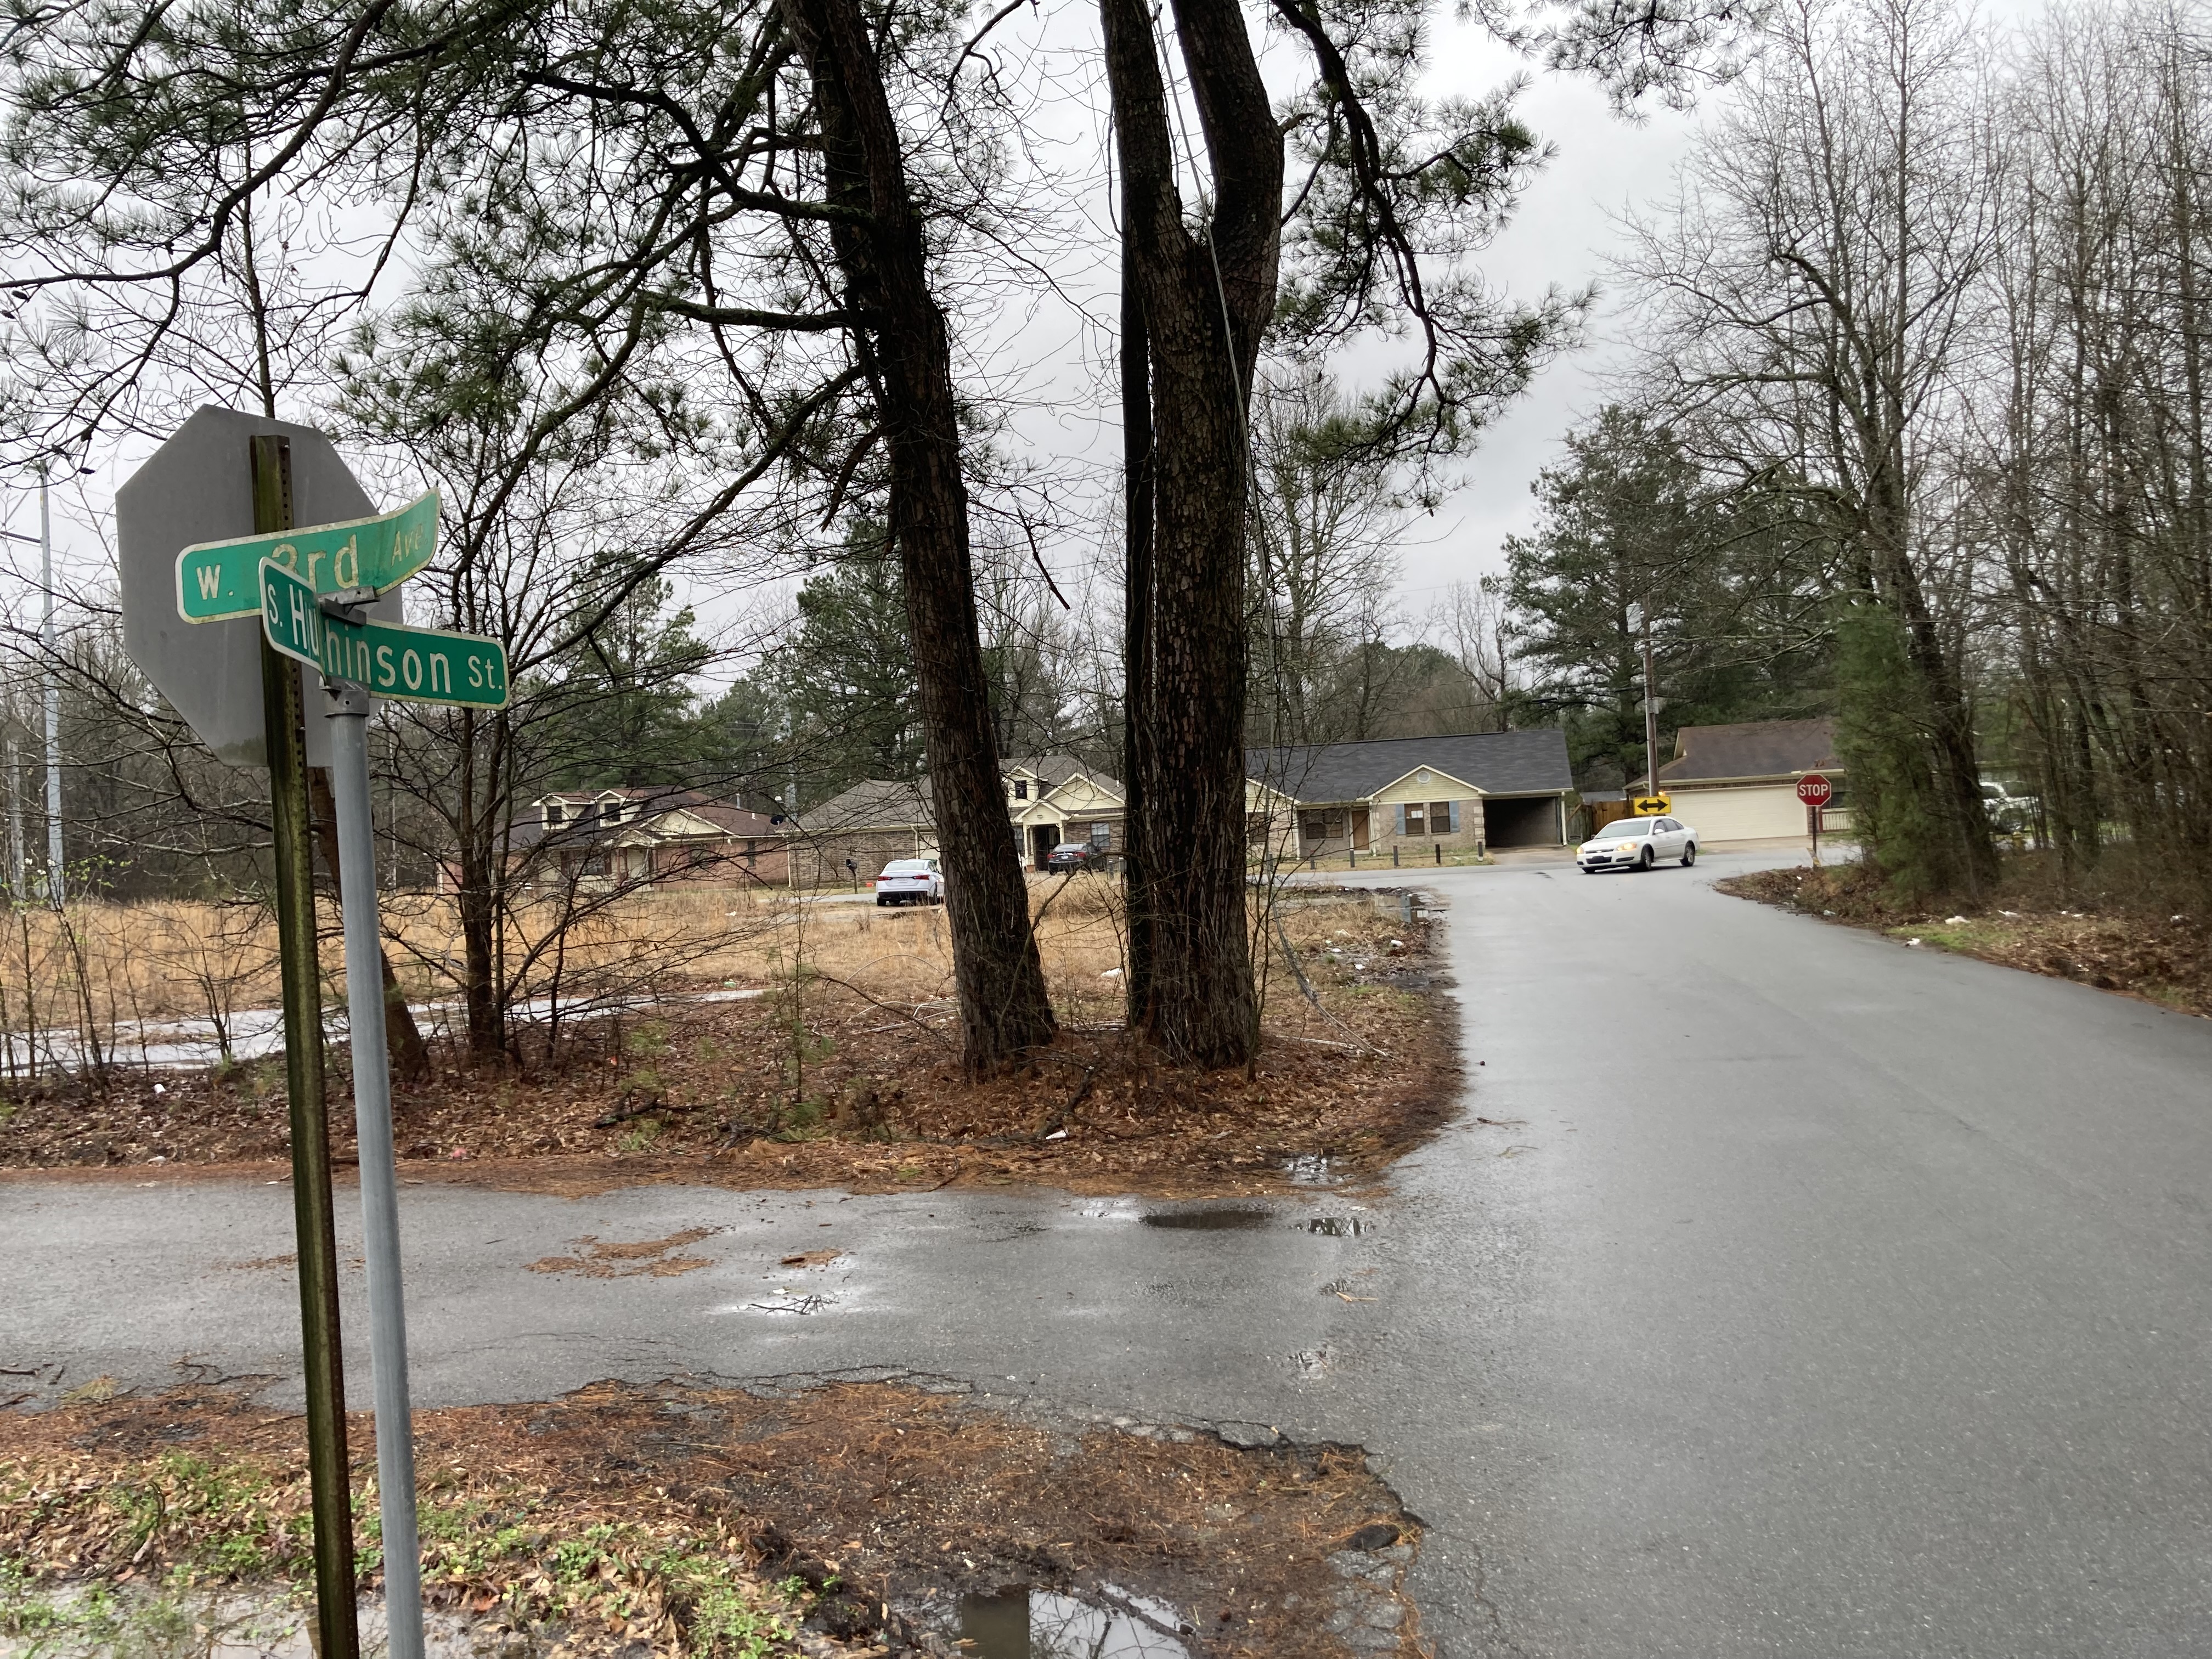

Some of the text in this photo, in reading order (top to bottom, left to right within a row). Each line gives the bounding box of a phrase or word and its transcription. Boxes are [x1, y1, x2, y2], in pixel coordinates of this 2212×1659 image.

[196, 564, 234, 600] W.
[267, 583, 502, 693] S. Huhinson St.
[1799, 784, 1829, 796] STOP
